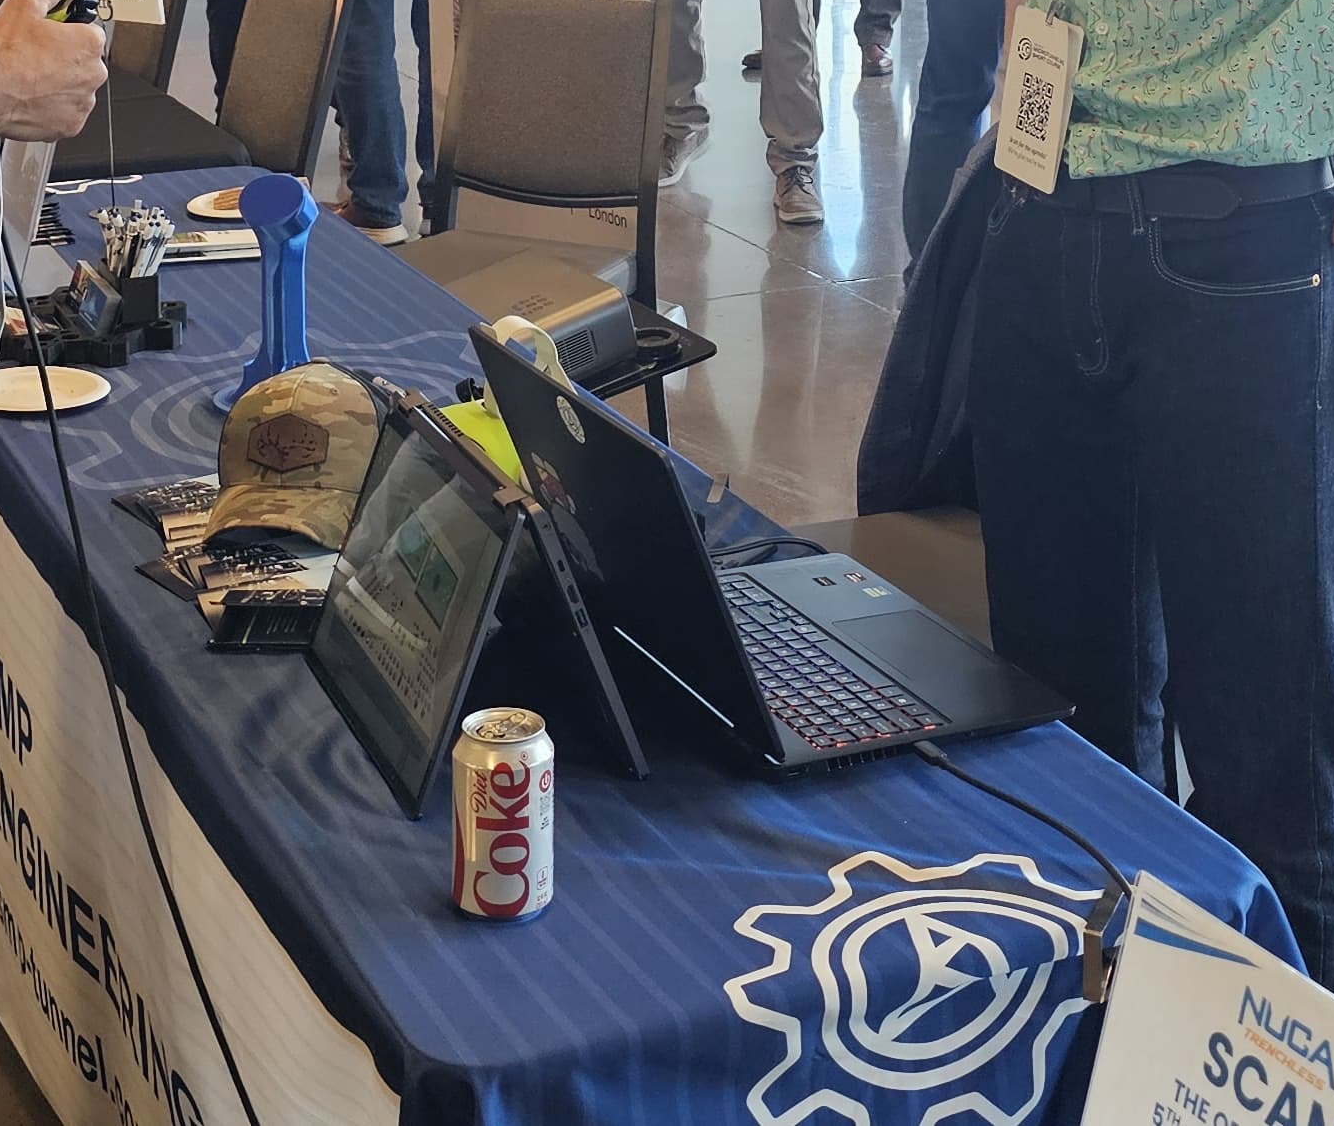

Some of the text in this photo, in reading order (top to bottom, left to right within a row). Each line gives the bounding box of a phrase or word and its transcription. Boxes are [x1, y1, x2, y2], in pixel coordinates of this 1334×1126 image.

[589, 207, 627, 229] London
[470, 770, 488, 814] Diet
[473, 760, 531, 918] Coke
[1243, 1026, 1328, 1092] TRENCHLESS
[1174, 1078, 1210, 1124] THE
